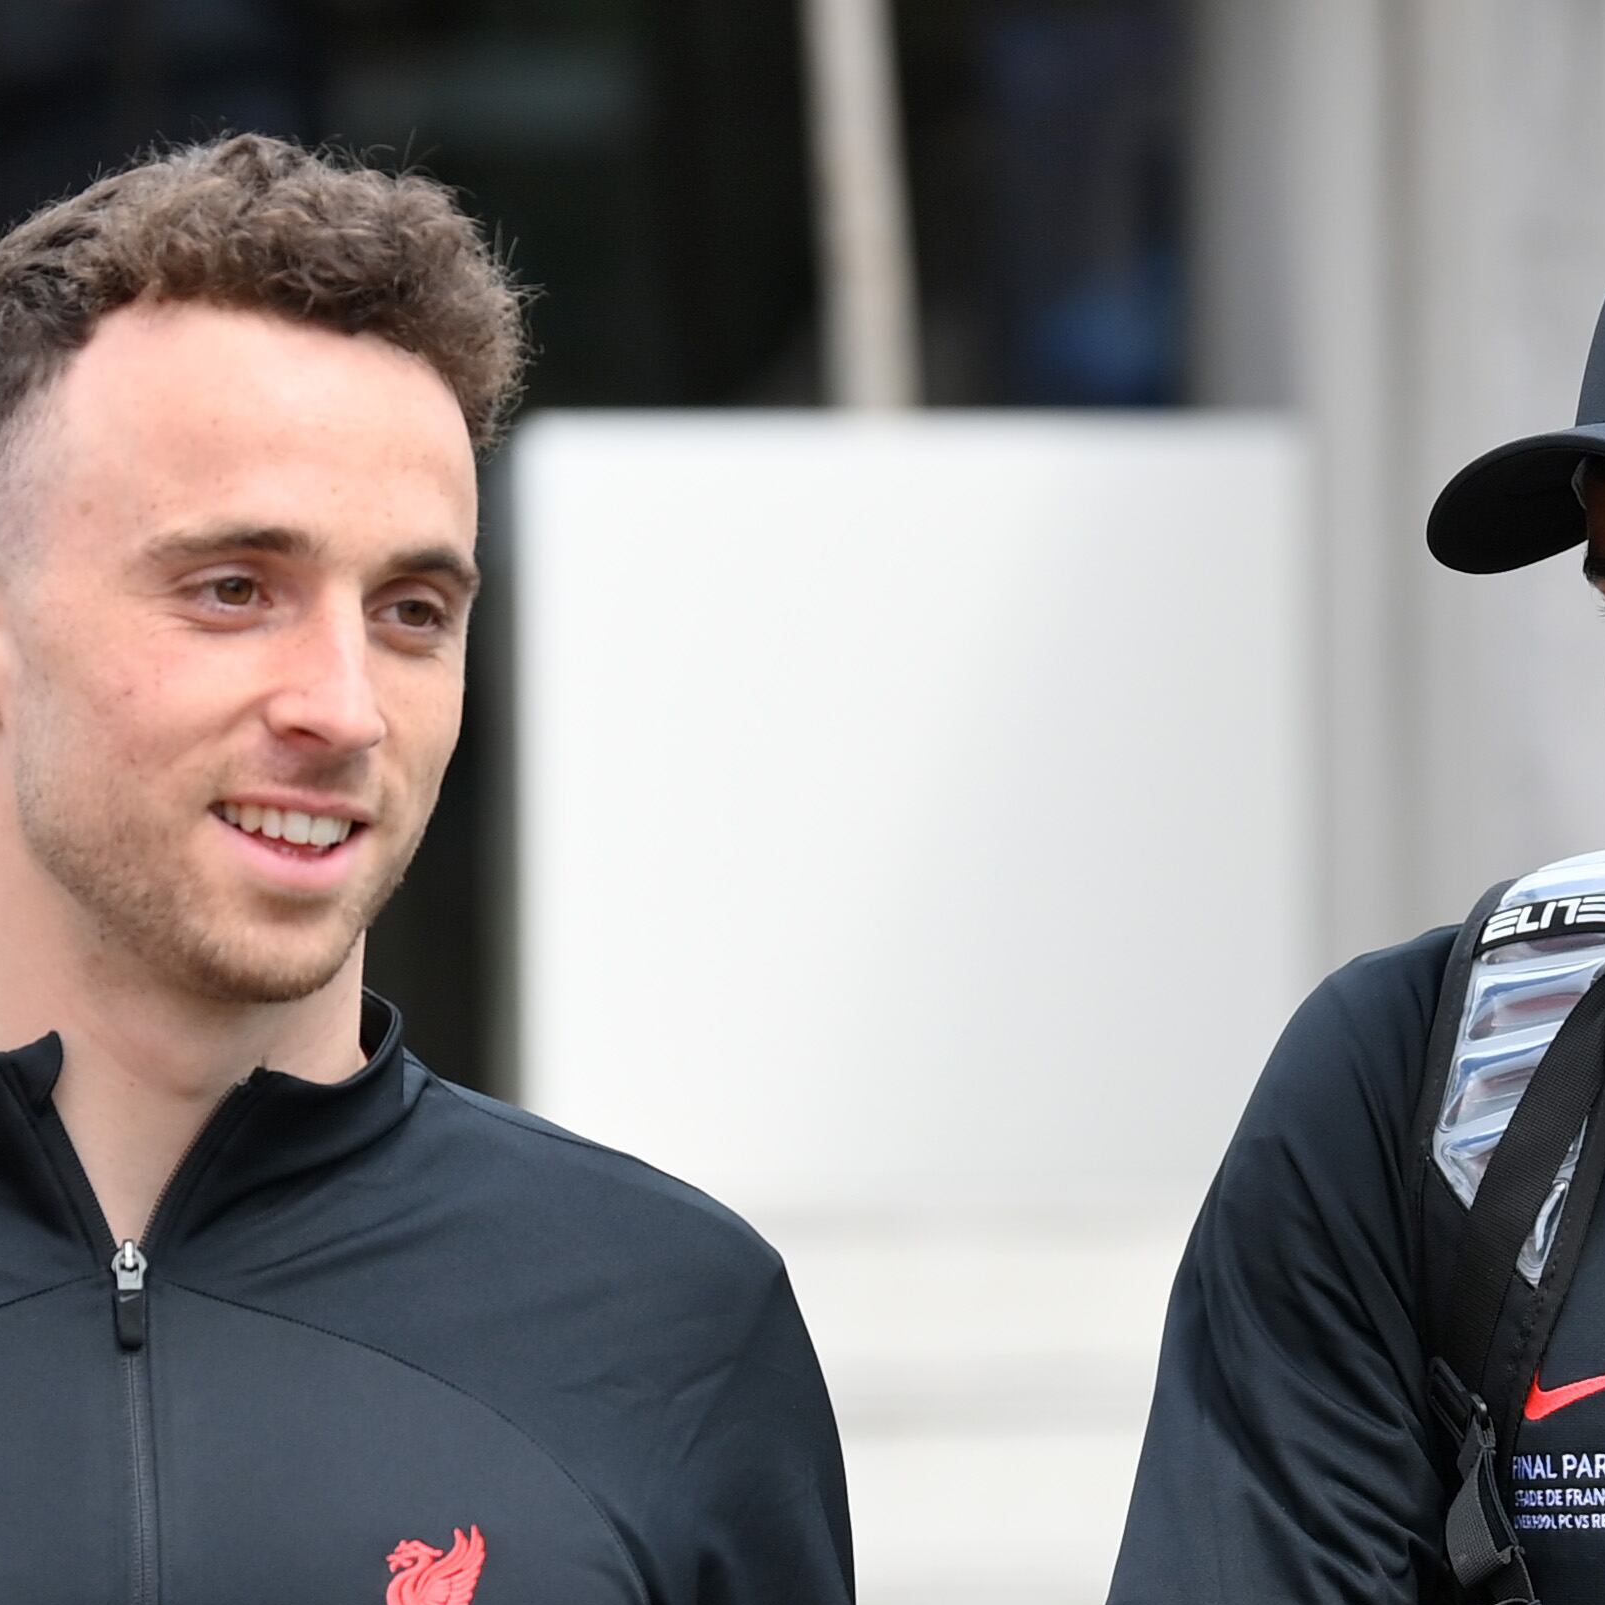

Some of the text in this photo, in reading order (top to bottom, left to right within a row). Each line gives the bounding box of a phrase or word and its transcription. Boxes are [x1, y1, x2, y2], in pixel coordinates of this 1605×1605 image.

[1512, 1454, 1558, 1480] FINAL
[1546, 1488, 1564, 1506] DE
[1574, 1513, 1589, 1529] VS
